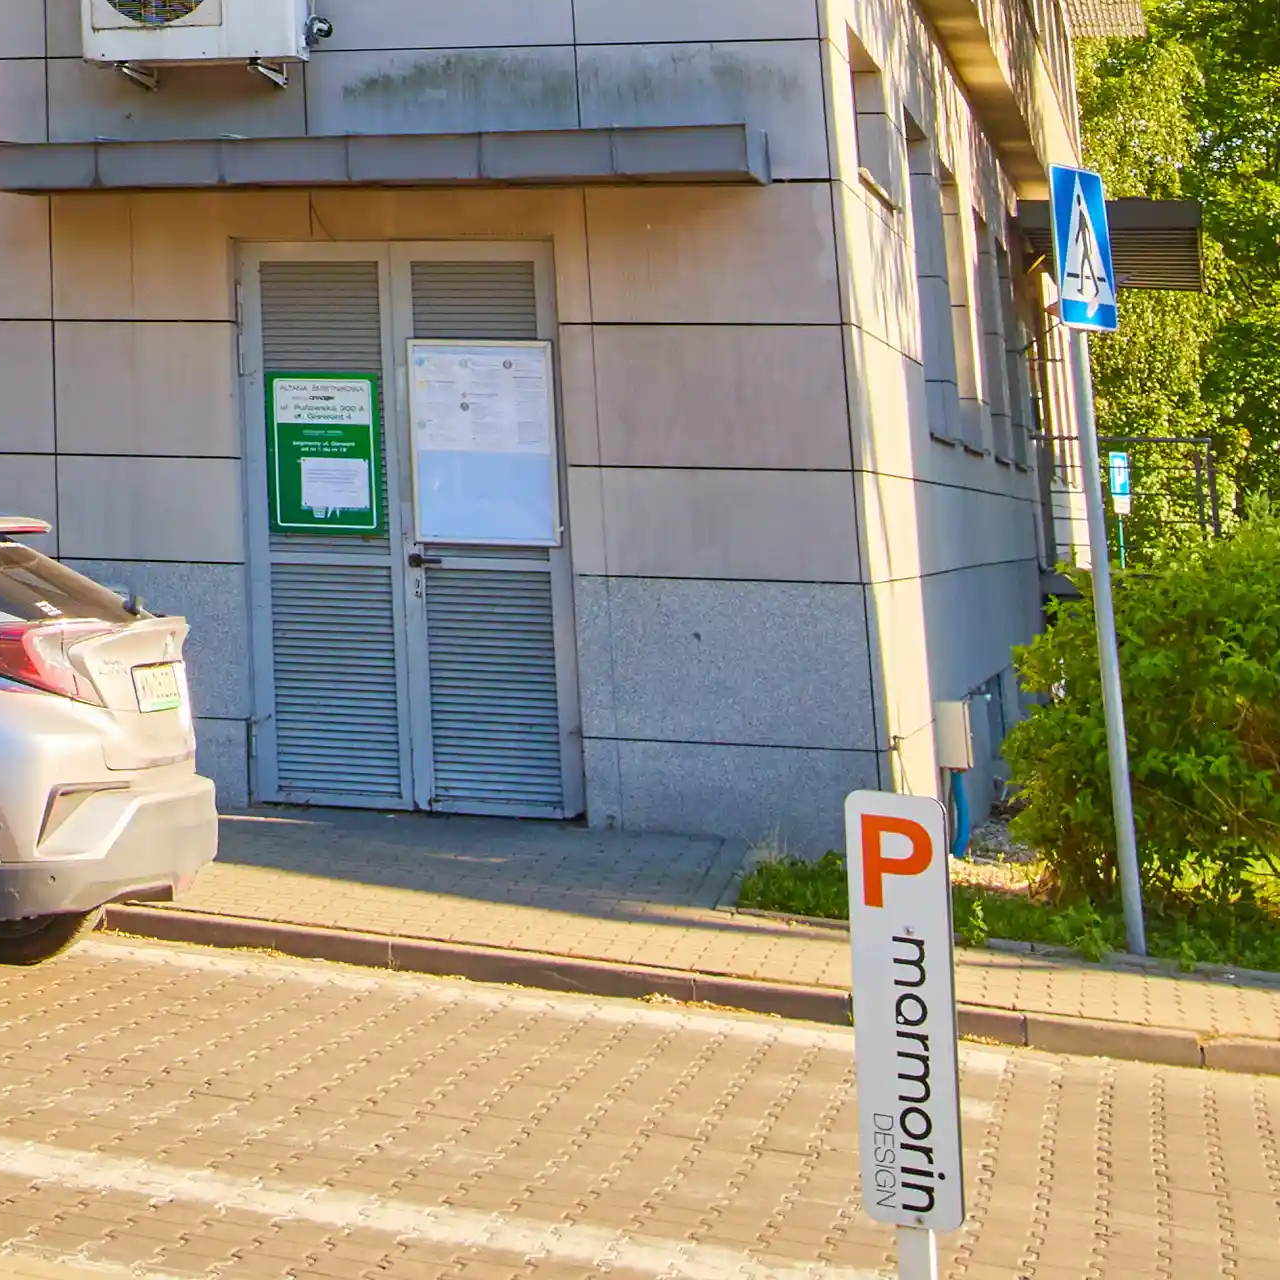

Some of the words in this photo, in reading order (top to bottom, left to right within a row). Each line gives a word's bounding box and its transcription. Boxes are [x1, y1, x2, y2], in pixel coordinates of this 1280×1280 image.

[860, 813, 933, 908] P
[891, 934, 947, 1214] marmorin
[873, 1112, 897, 1209] DESIGN
